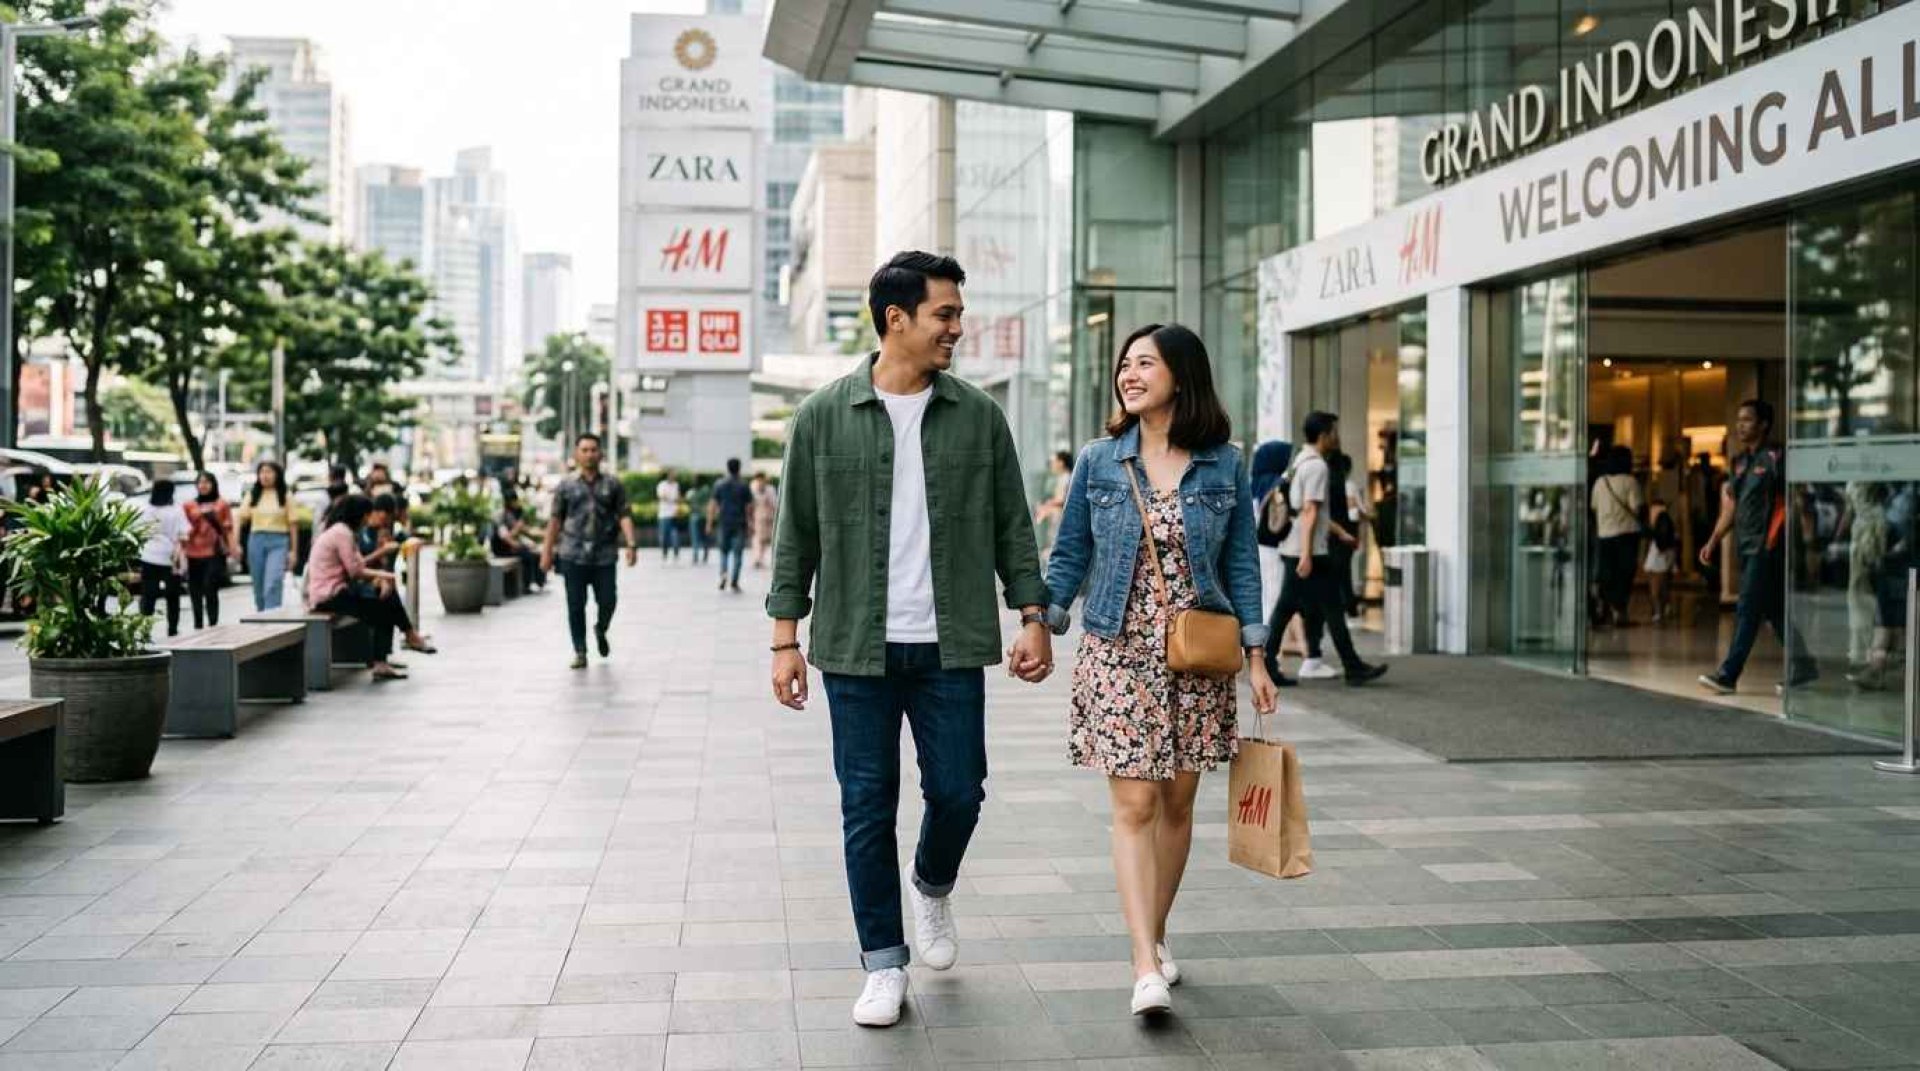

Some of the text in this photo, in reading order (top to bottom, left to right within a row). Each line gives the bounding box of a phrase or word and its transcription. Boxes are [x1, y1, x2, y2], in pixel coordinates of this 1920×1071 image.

[639, 94, 750, 113] INDONESIA
[659, 77, 731, 93] GRAND
[1421, 0, 1839, 184] GRAND INDONES
[1500, 40, 1920, 244] WELCOMING ALL
[647, 154, 739, 181] ZARA
[1318, 242, 1376, 299] ZARA
